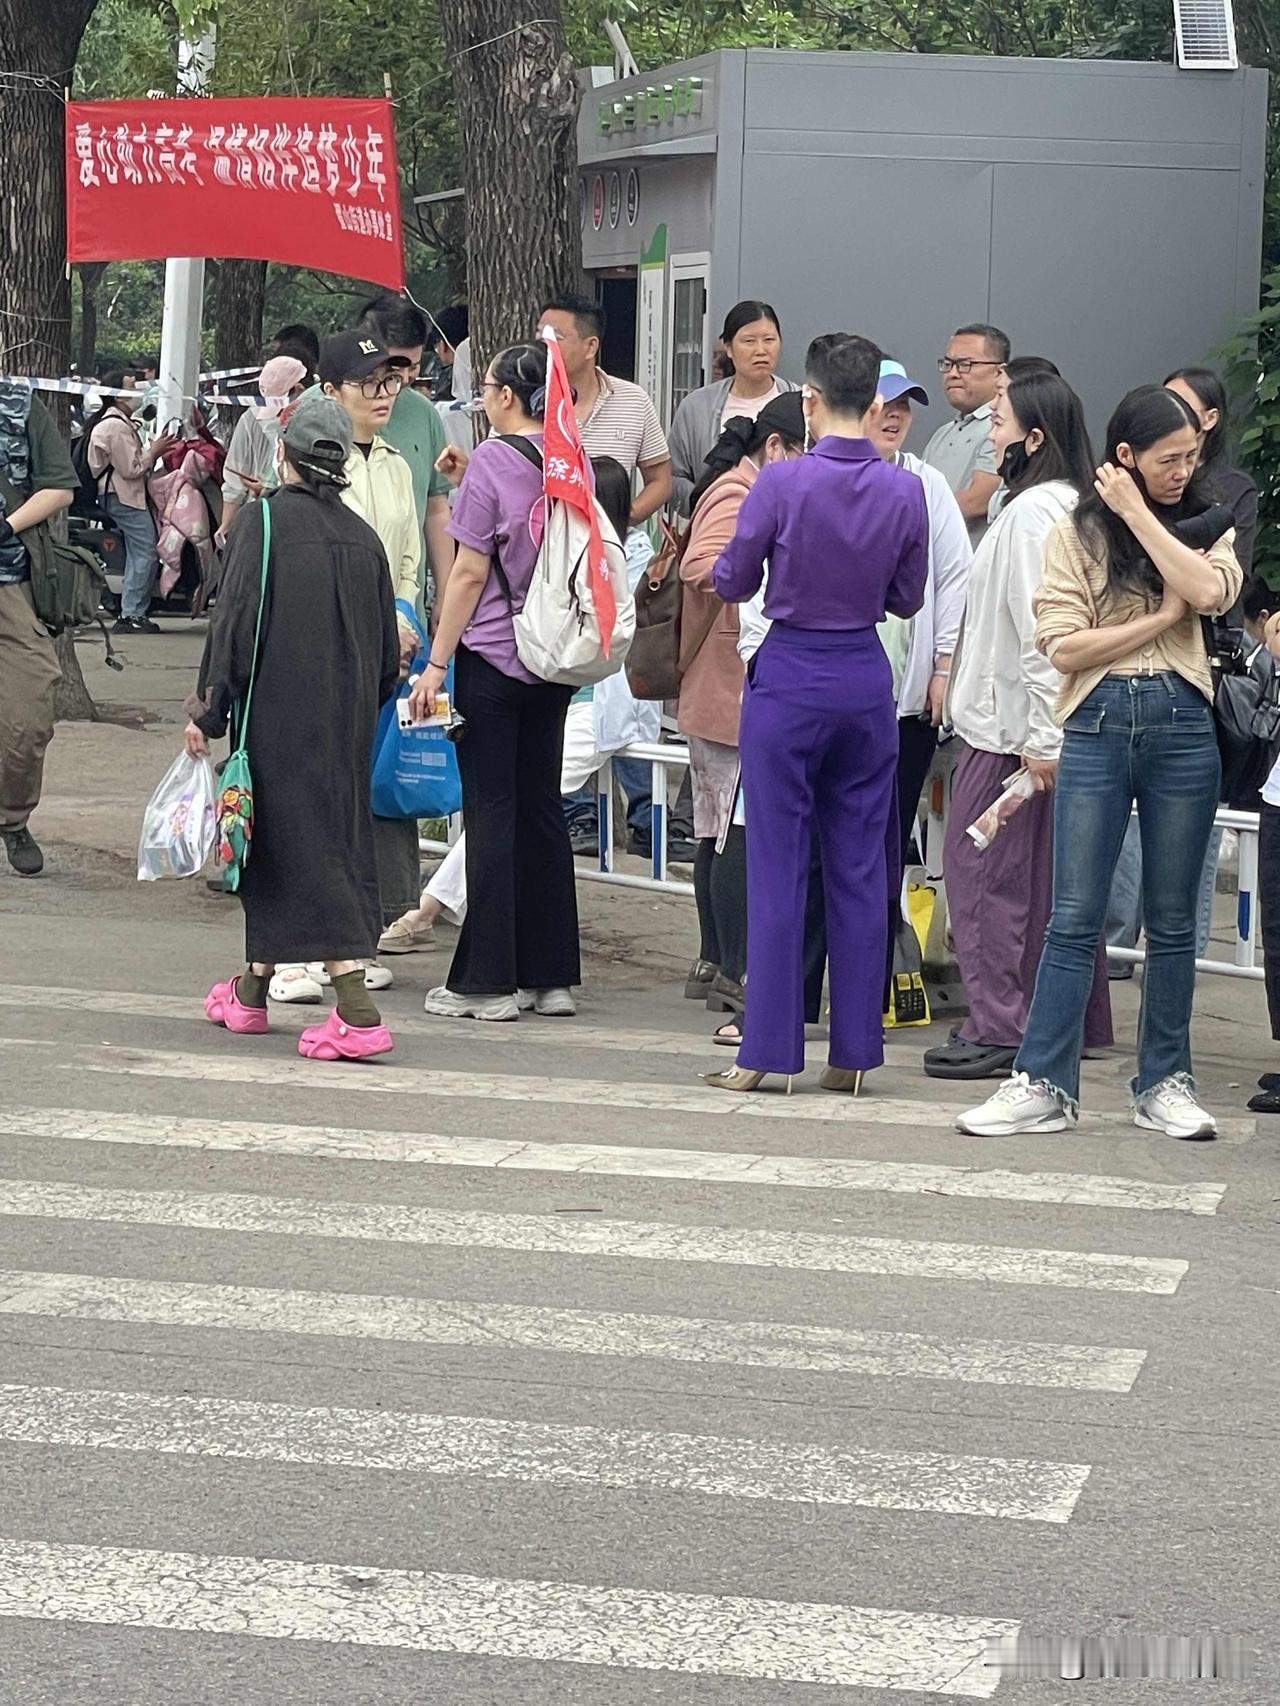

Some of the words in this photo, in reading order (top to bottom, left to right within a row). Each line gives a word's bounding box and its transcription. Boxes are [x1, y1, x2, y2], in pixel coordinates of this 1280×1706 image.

[75, 122, 204, 187] 爱心助力高考
[204, 122, 386, 203] 温情相伴追梦少年
